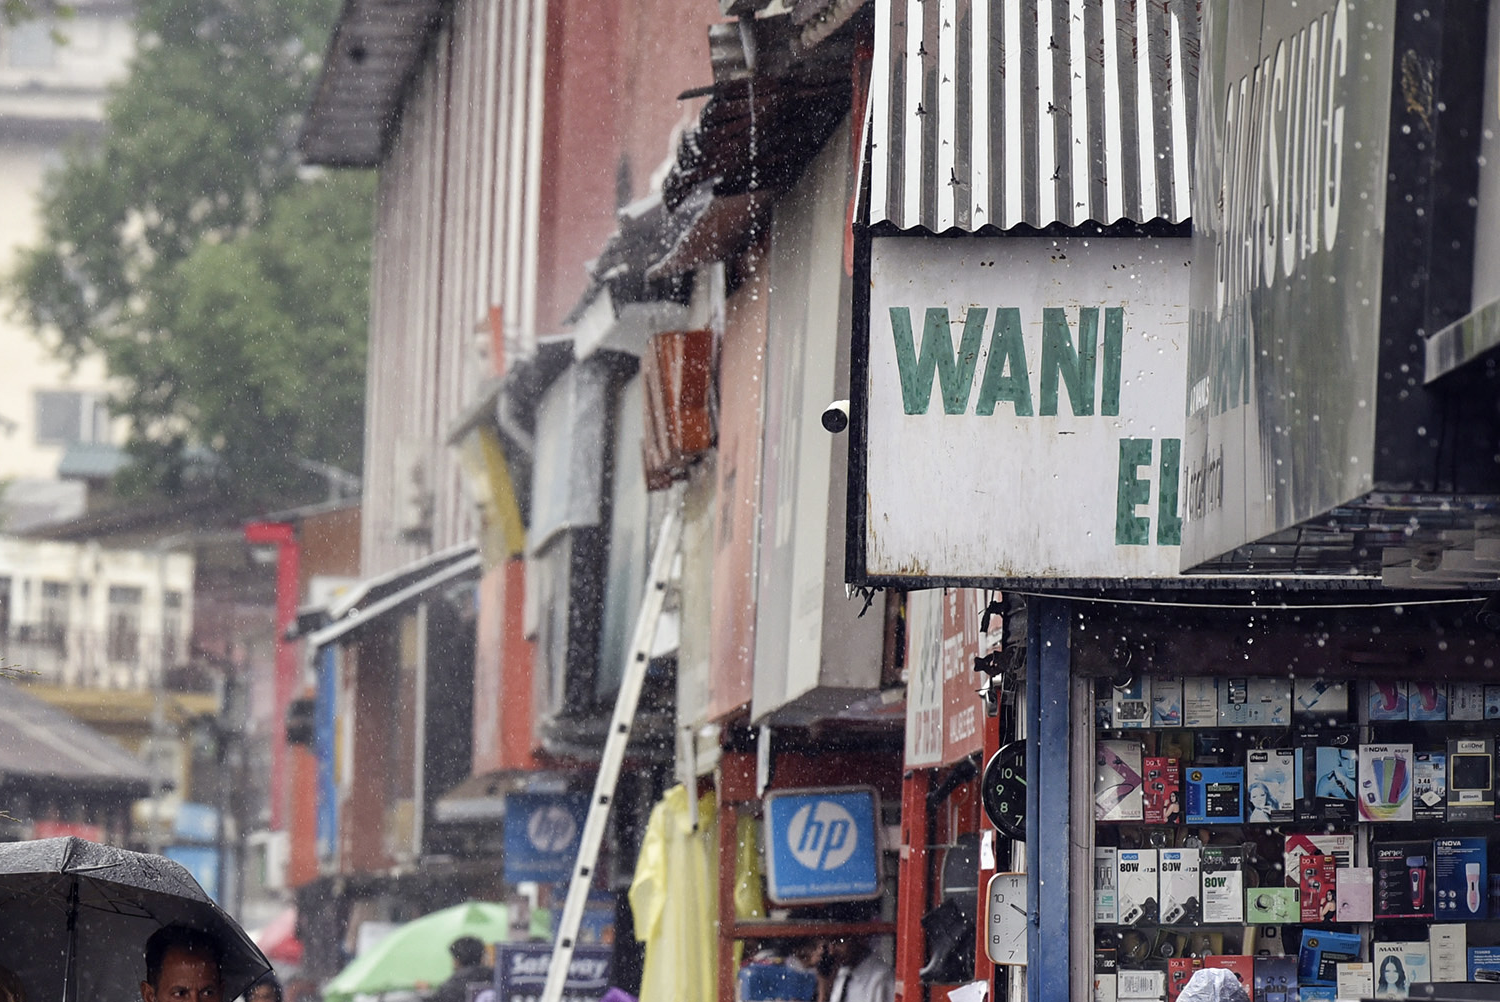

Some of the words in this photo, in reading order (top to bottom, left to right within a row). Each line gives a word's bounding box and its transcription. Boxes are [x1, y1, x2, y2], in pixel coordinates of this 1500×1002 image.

[1217, 0, 1348, 322] SAMSUNG
[889, 306, 1124, 418] WANI
[1016, 755, 1023, 767] 11
[1001, 768, 1013, 779] 10
[996, 785, 1004, 795] 9
[1000, 802, 1008, 813] 8
[1015, 815, 1023, 827] 7
[796, 802, 851, 870] hp
[1119, 862, 1140, 873] 80W
[1162, 862, 1182, 872] 80W
[1010, 879, 1019, 888] 11
[1204, 877, 1227, 888] 80W
[994, 893, 1005, 903] 10
[993, 914, 1001, 924] 9
[992, 934, 1000, 944] 8
[1008, 951, 1015, 959] 7
[510, 956, 608, 983] Safway
